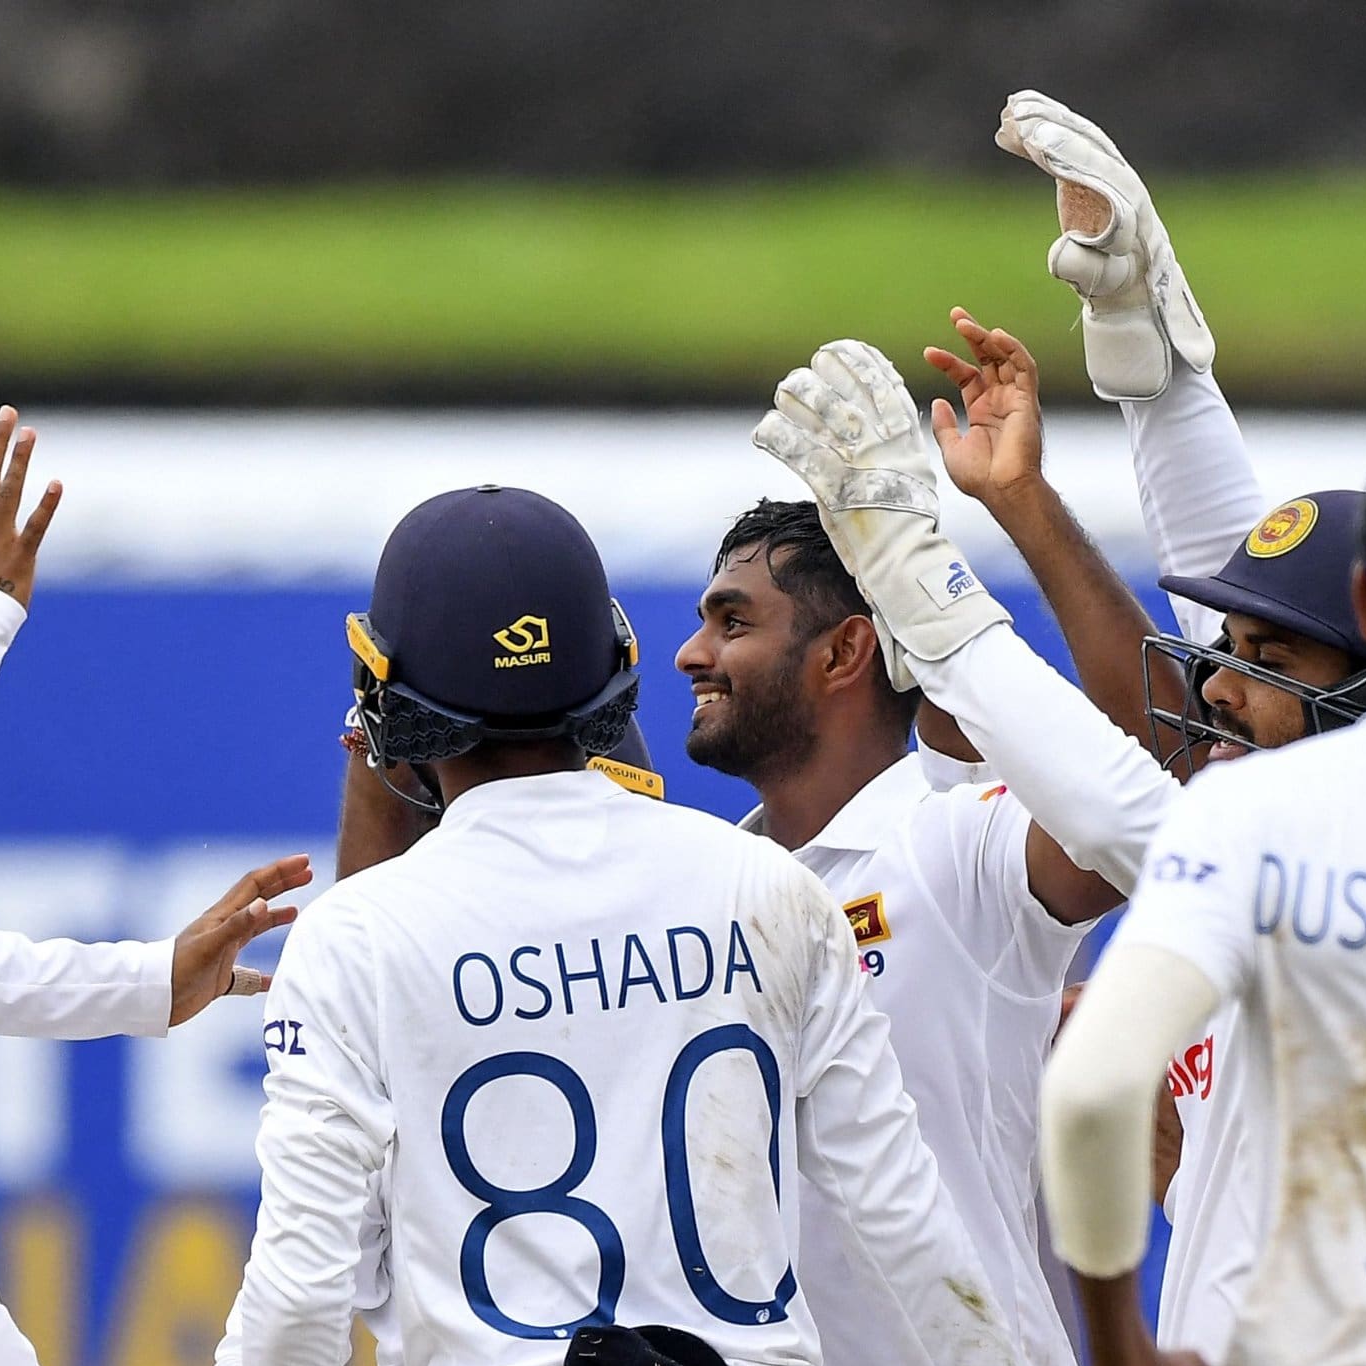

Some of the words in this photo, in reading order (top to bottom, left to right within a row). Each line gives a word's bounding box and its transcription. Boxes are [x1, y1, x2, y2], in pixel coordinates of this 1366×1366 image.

[494, 652, 551, 668] MASURI
[593, 762, 641, 781] MASURI
[452, 920, 763, 1027] OSHADA
[441, 1023, 798, 1340] 80
